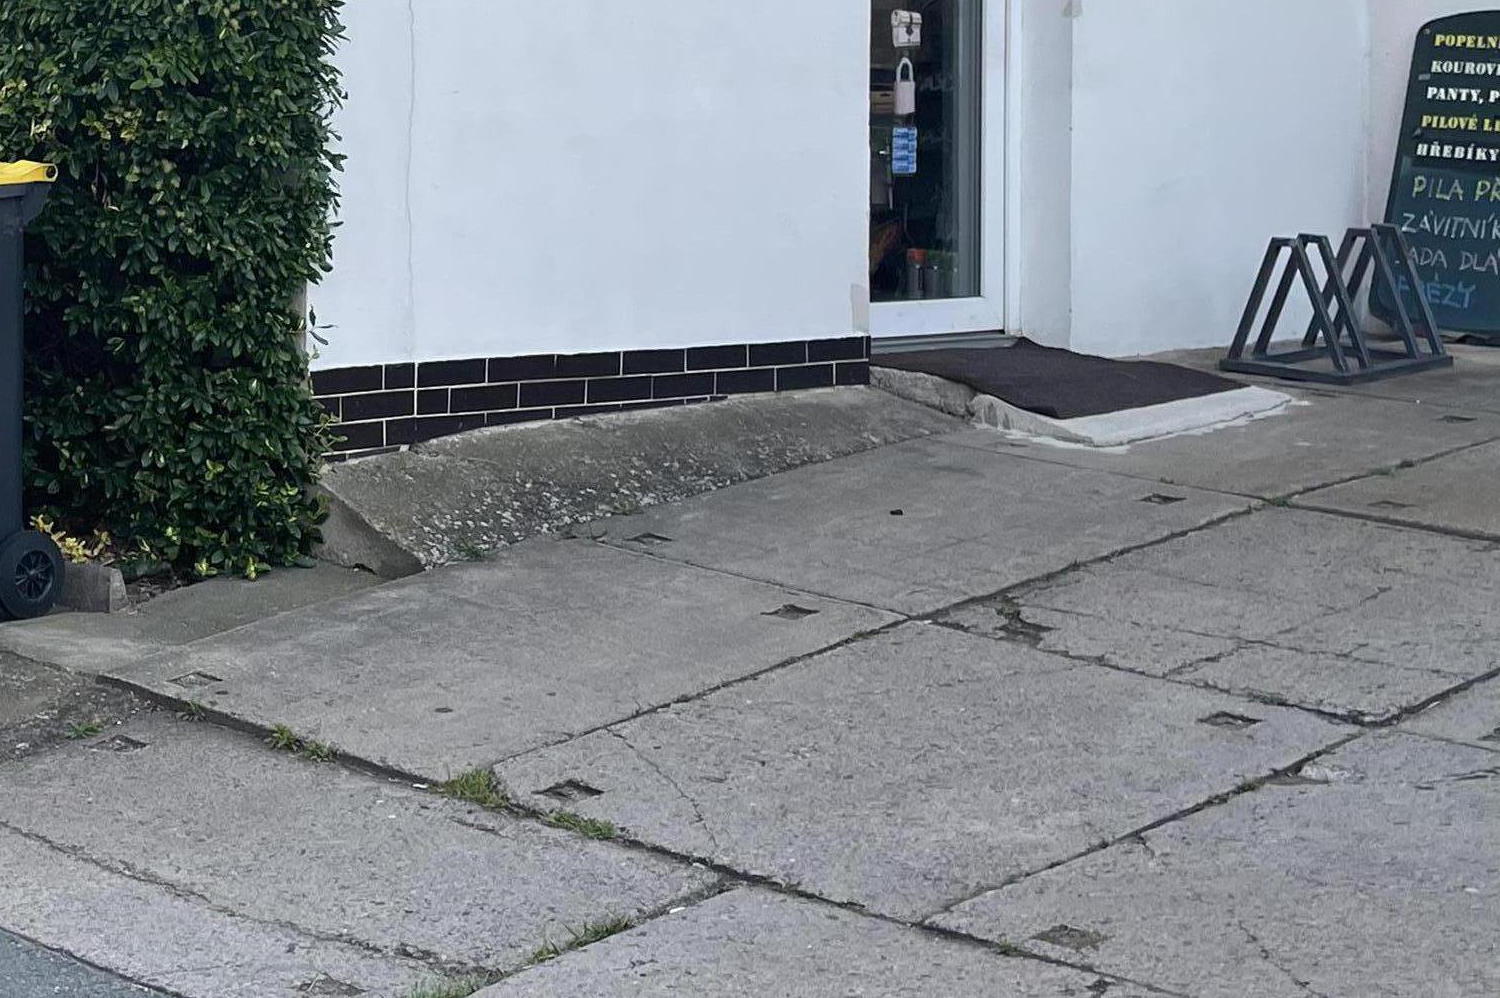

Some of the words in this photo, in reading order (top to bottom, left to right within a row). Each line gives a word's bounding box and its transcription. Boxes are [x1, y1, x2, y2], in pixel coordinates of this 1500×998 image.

[1434, 34, 1500, 49] POPELN
[1426, 86, 1484, 104] PANTY,
[1421, 113, 1478, 130] PILOVÉ
[1416, 141, 1500, 162] HŘEBÍKY
[1412, 174, 1464, 201] PILA
[1396, 245, 1448, 269] ADA
